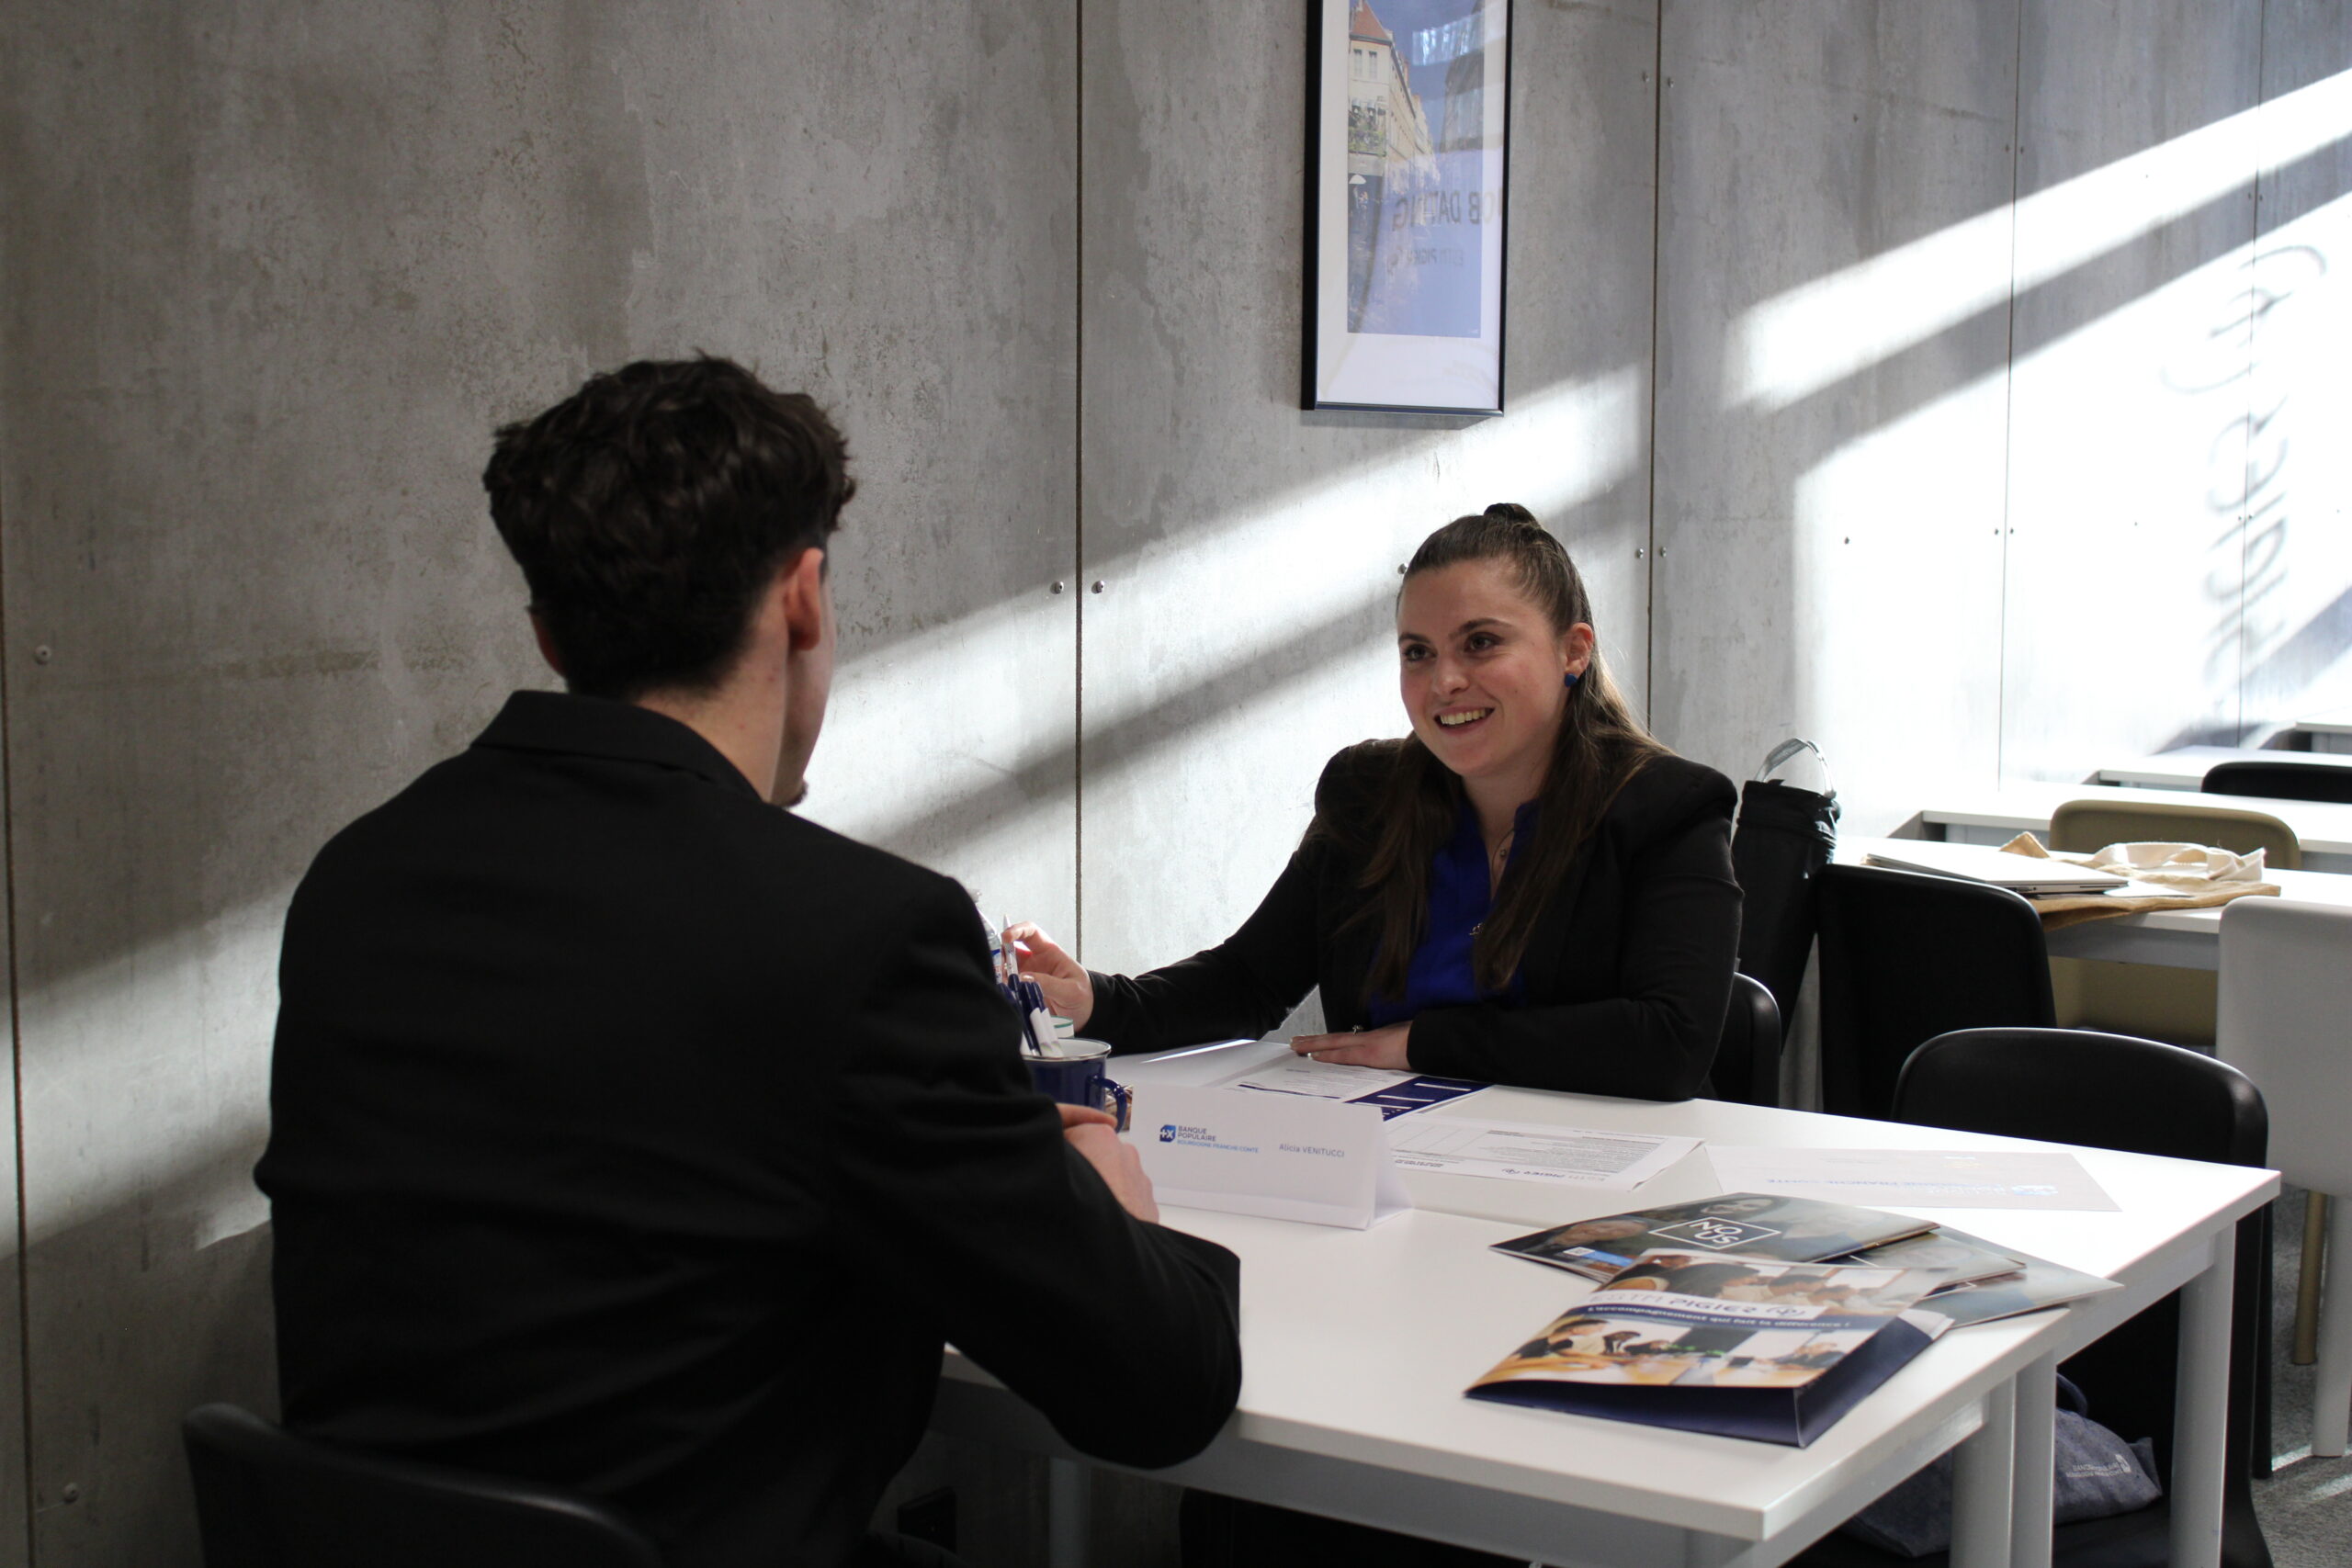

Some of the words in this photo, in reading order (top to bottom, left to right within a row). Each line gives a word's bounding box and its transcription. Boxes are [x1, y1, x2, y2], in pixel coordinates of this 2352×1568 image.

[1178, 1125, 1207, 1134] BANQUE
[1177, 1132, 1216, 1142] POPULAIRE
[1279, 1143, 1301, 1153] Alicia
[1302, 1145, 1346, 1157] VENITUCCI
